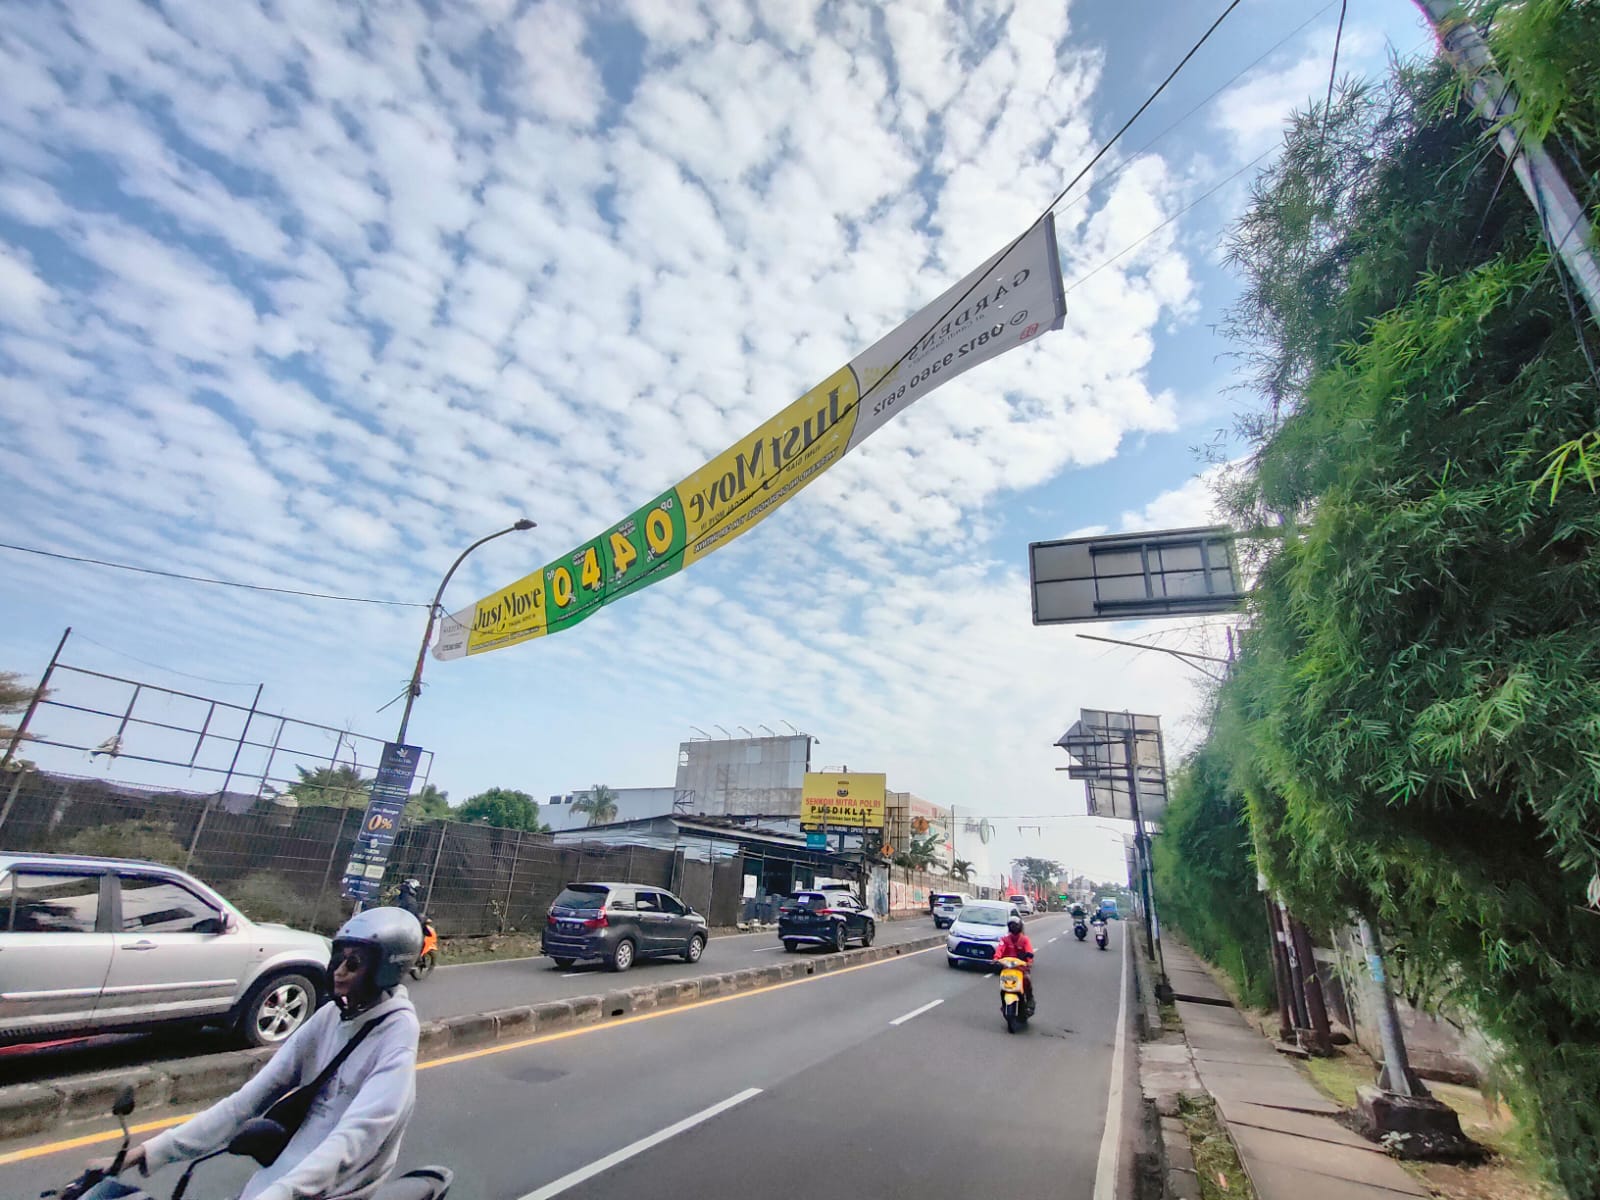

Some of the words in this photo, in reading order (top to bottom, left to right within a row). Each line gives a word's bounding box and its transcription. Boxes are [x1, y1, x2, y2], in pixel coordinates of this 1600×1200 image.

[835, 798, 858, 807] MITRA
[859, 799, 881, 808] POLRI
[811, 805, 873, 816] PUSDIKLAT
[368, 814, 394, 831] 0%
